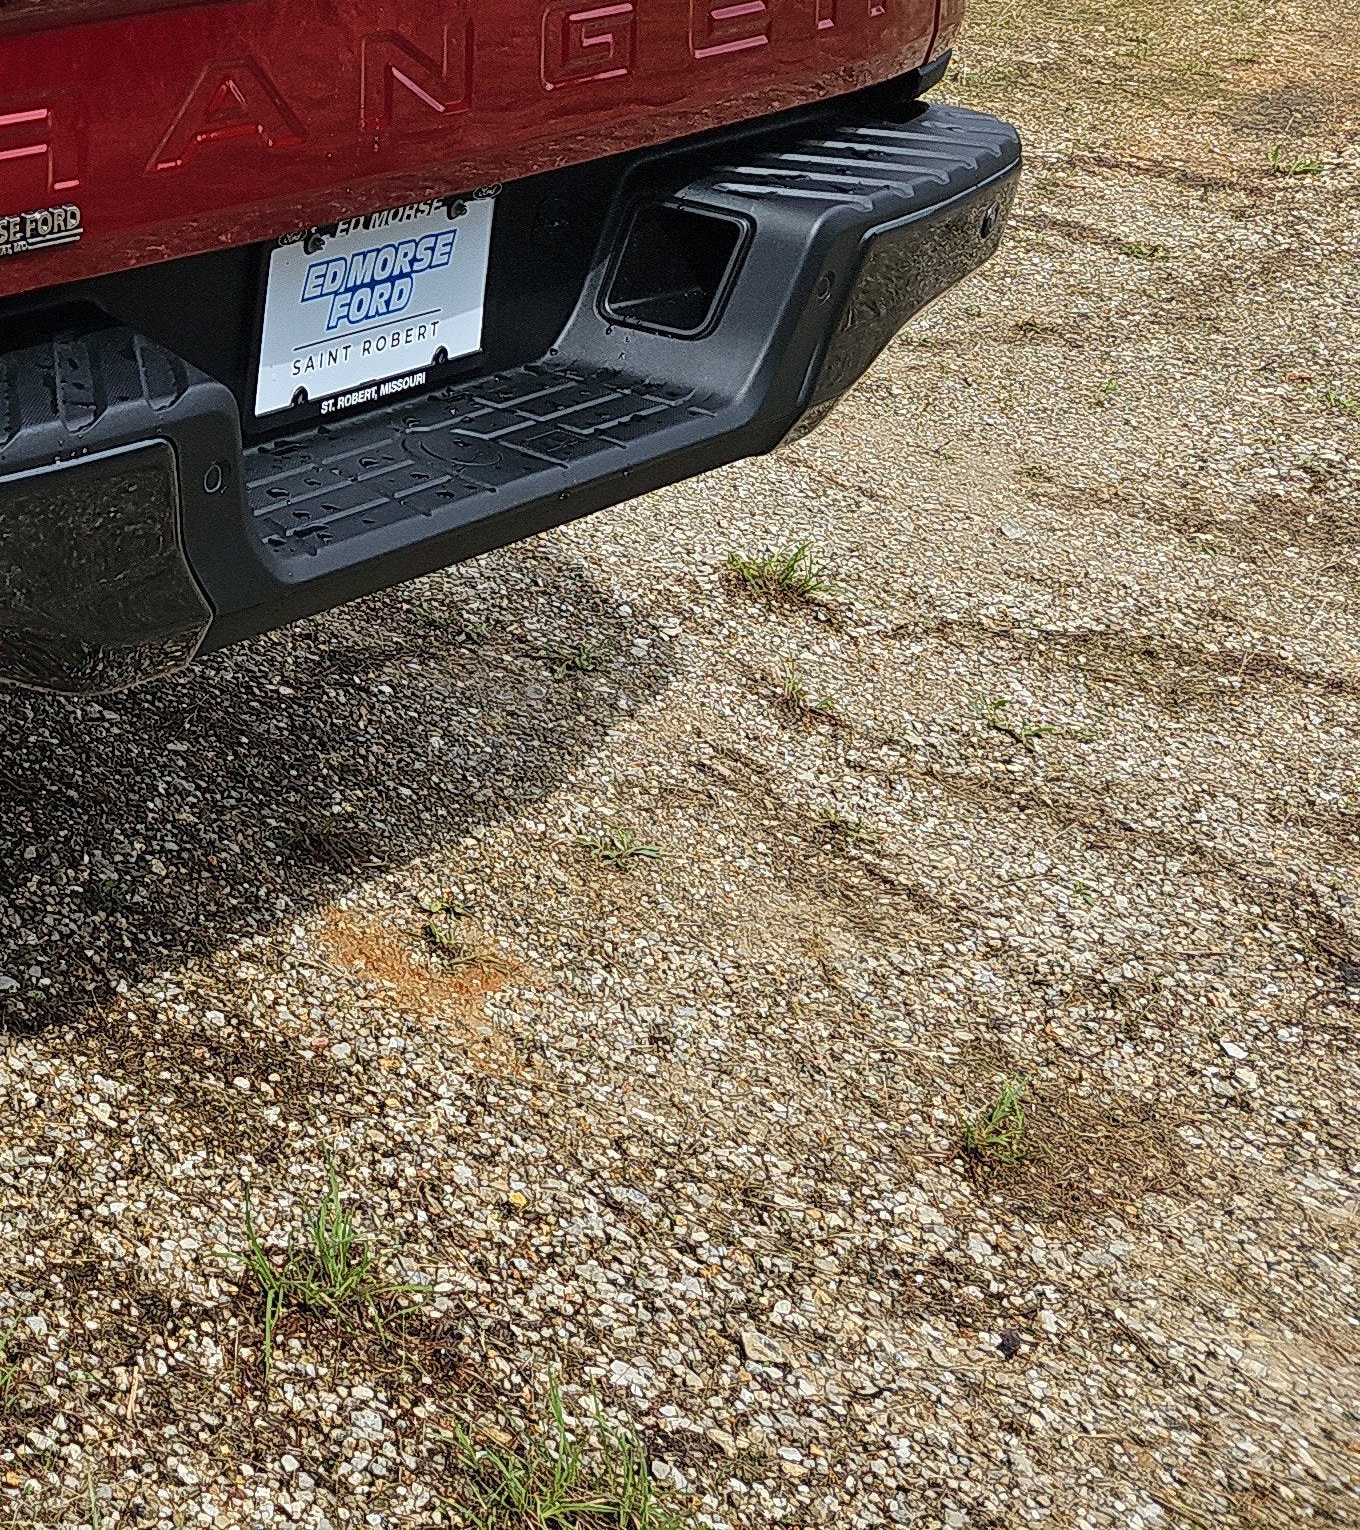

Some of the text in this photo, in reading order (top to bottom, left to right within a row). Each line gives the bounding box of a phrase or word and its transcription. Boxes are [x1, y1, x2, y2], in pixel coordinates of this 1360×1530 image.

[21, 203, 81, 239] FORD
[326, 273, 418, 331] FORD
[292, 320, 441, 376] SAINT ROBERT
[320, 371, 427, 414] ST. ROBERT, MISSOURI
